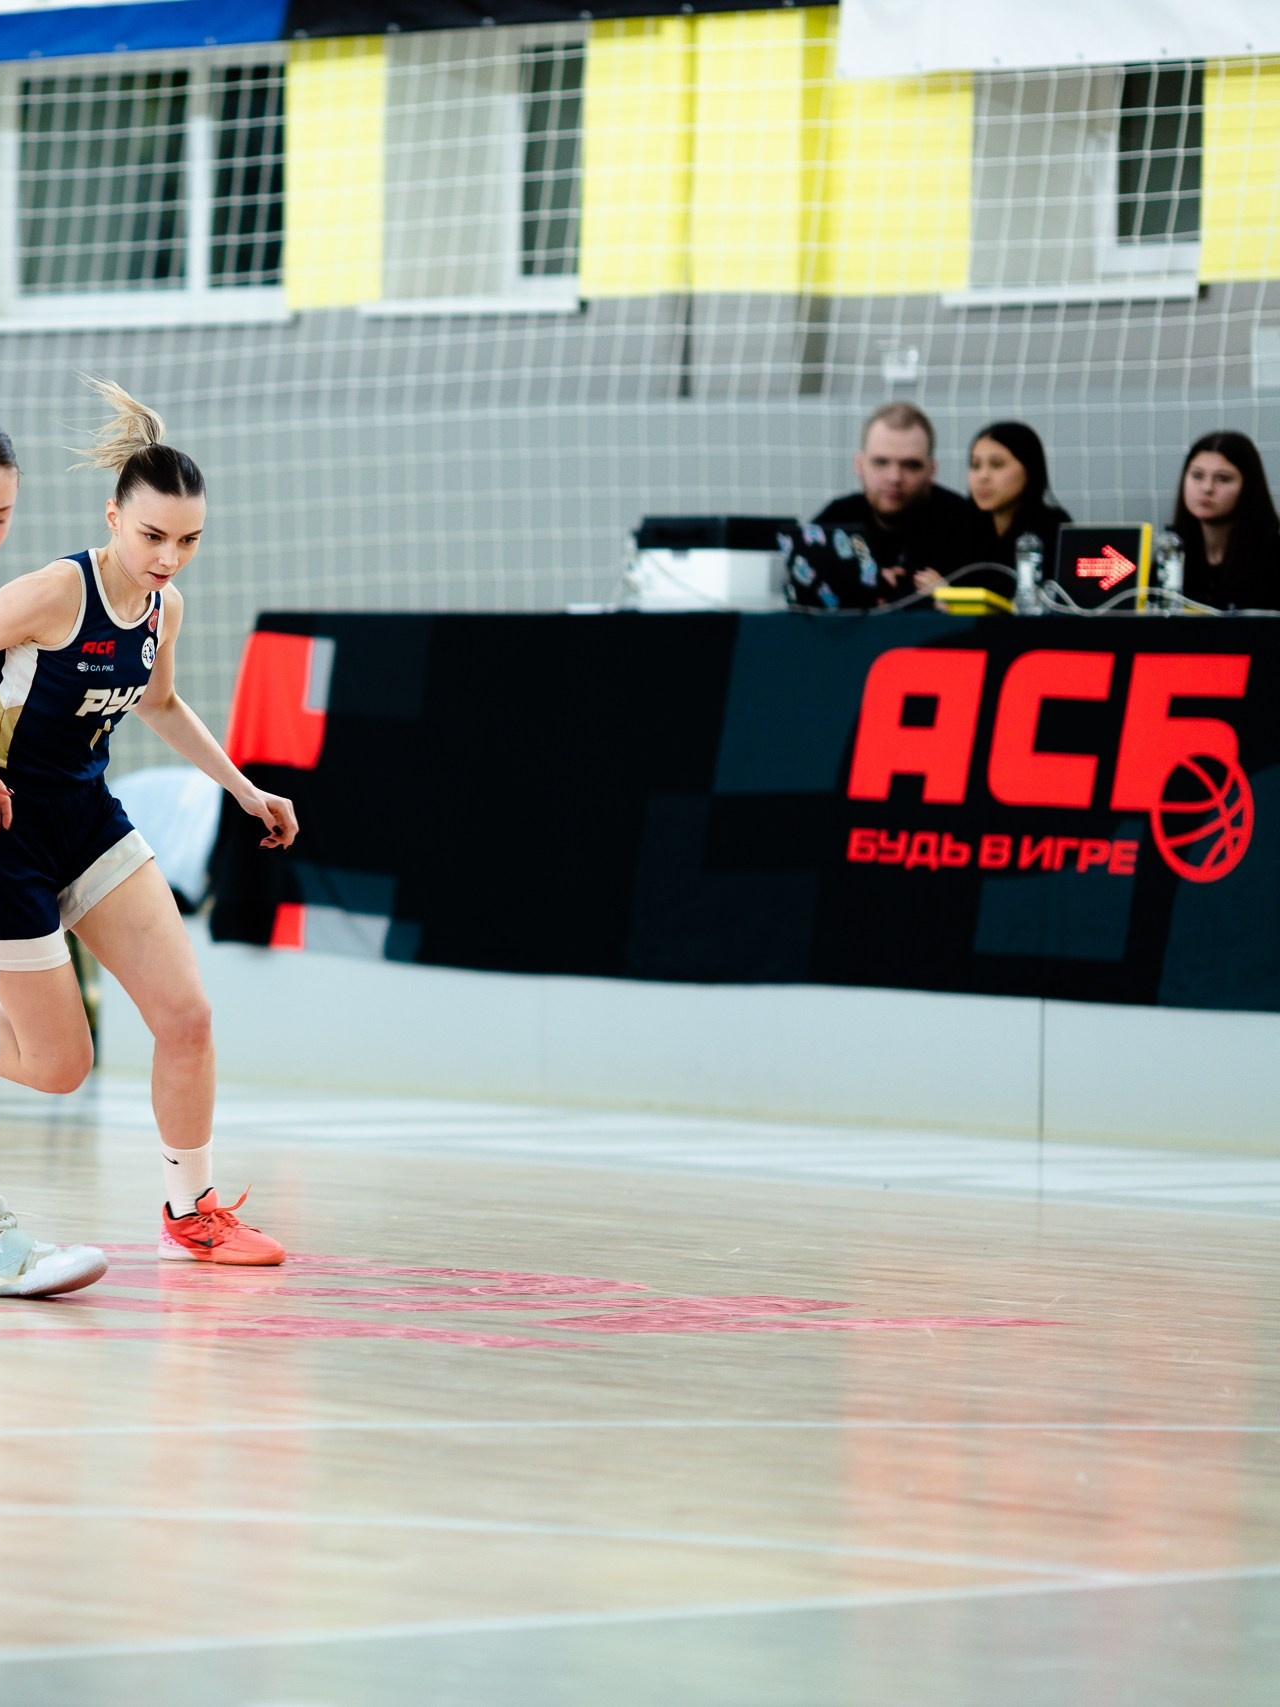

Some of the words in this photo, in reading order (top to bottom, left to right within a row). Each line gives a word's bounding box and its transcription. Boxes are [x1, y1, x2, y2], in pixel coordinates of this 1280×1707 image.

[847, 647, 1251, 812] АСБ
[846, 828, 971, 870] БУДЬ
[978, 835, 1011, 869] В
[1018, 836, 1139, 876] ИГРЕ
